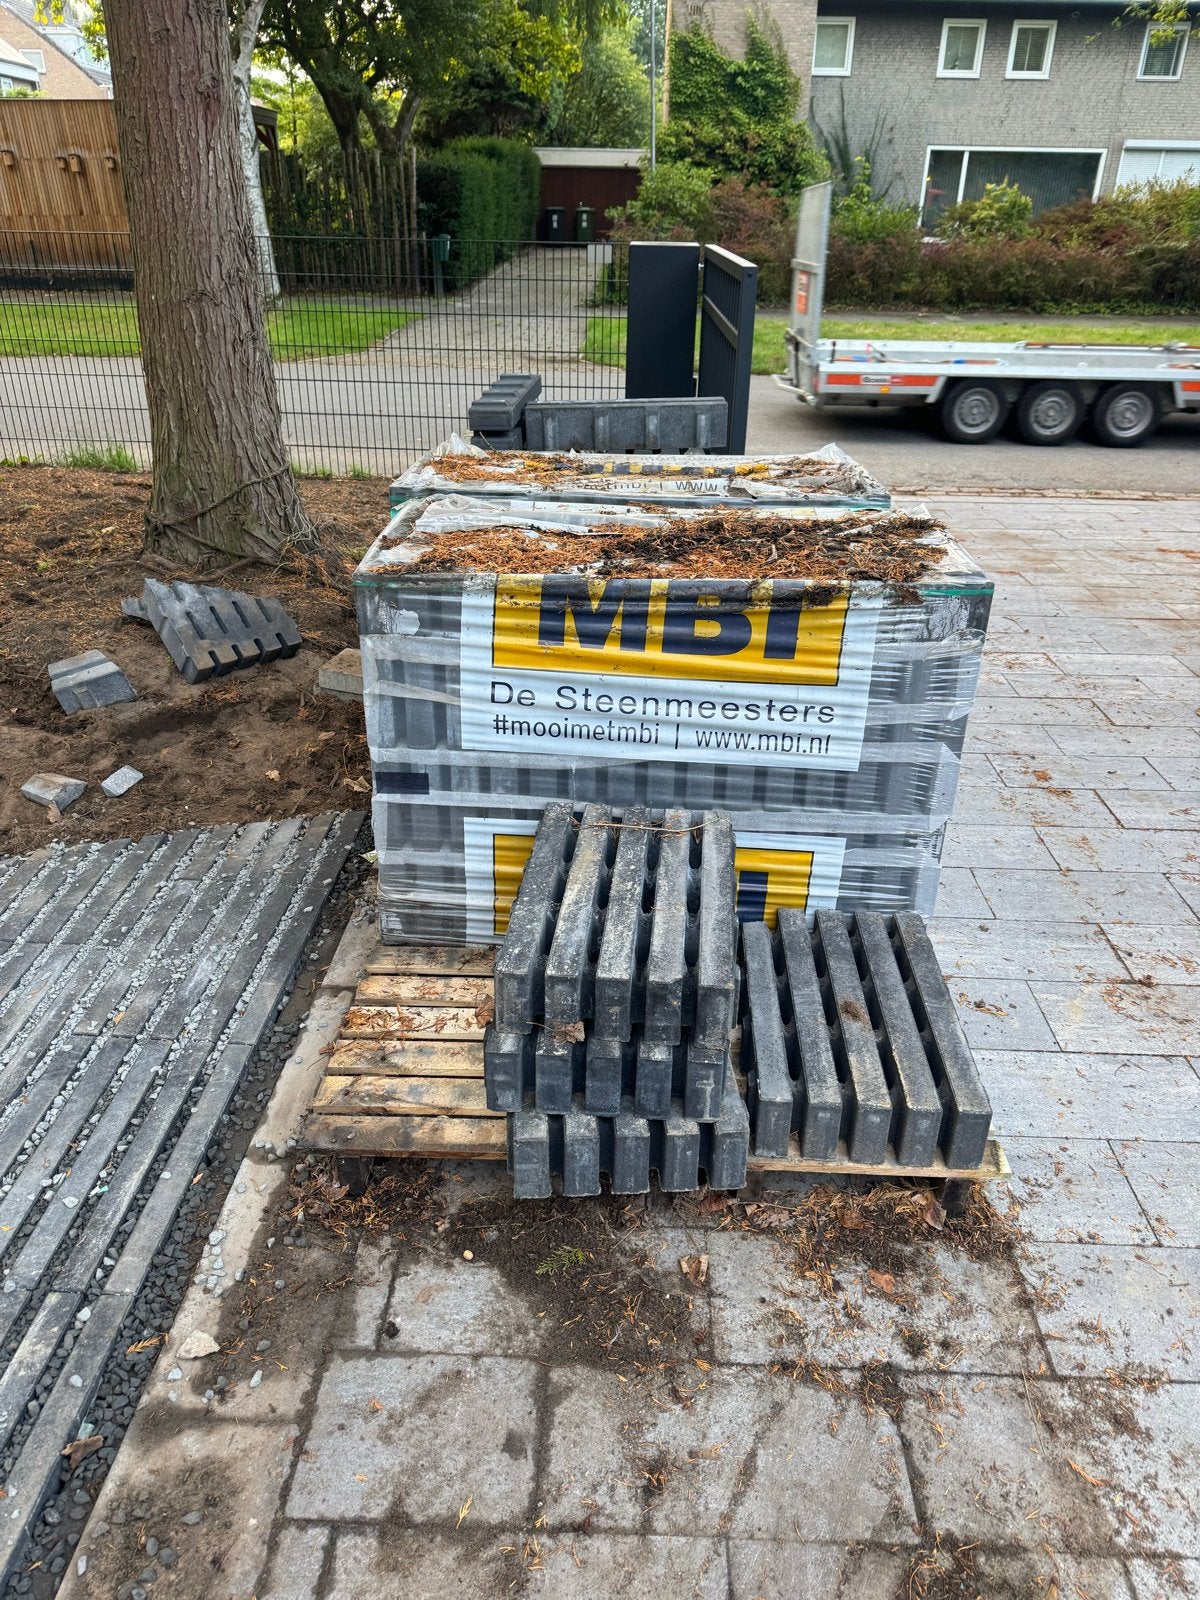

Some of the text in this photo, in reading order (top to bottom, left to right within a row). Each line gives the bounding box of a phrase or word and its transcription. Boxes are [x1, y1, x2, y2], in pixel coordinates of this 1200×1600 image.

[538, 577, 804, 659] MBI
[490, 680, 835, 724] De Steenmeesters
[492, 714, 660, 745] #mooimetmbi
[695, 730, 831, 754] www.mbi.nl
